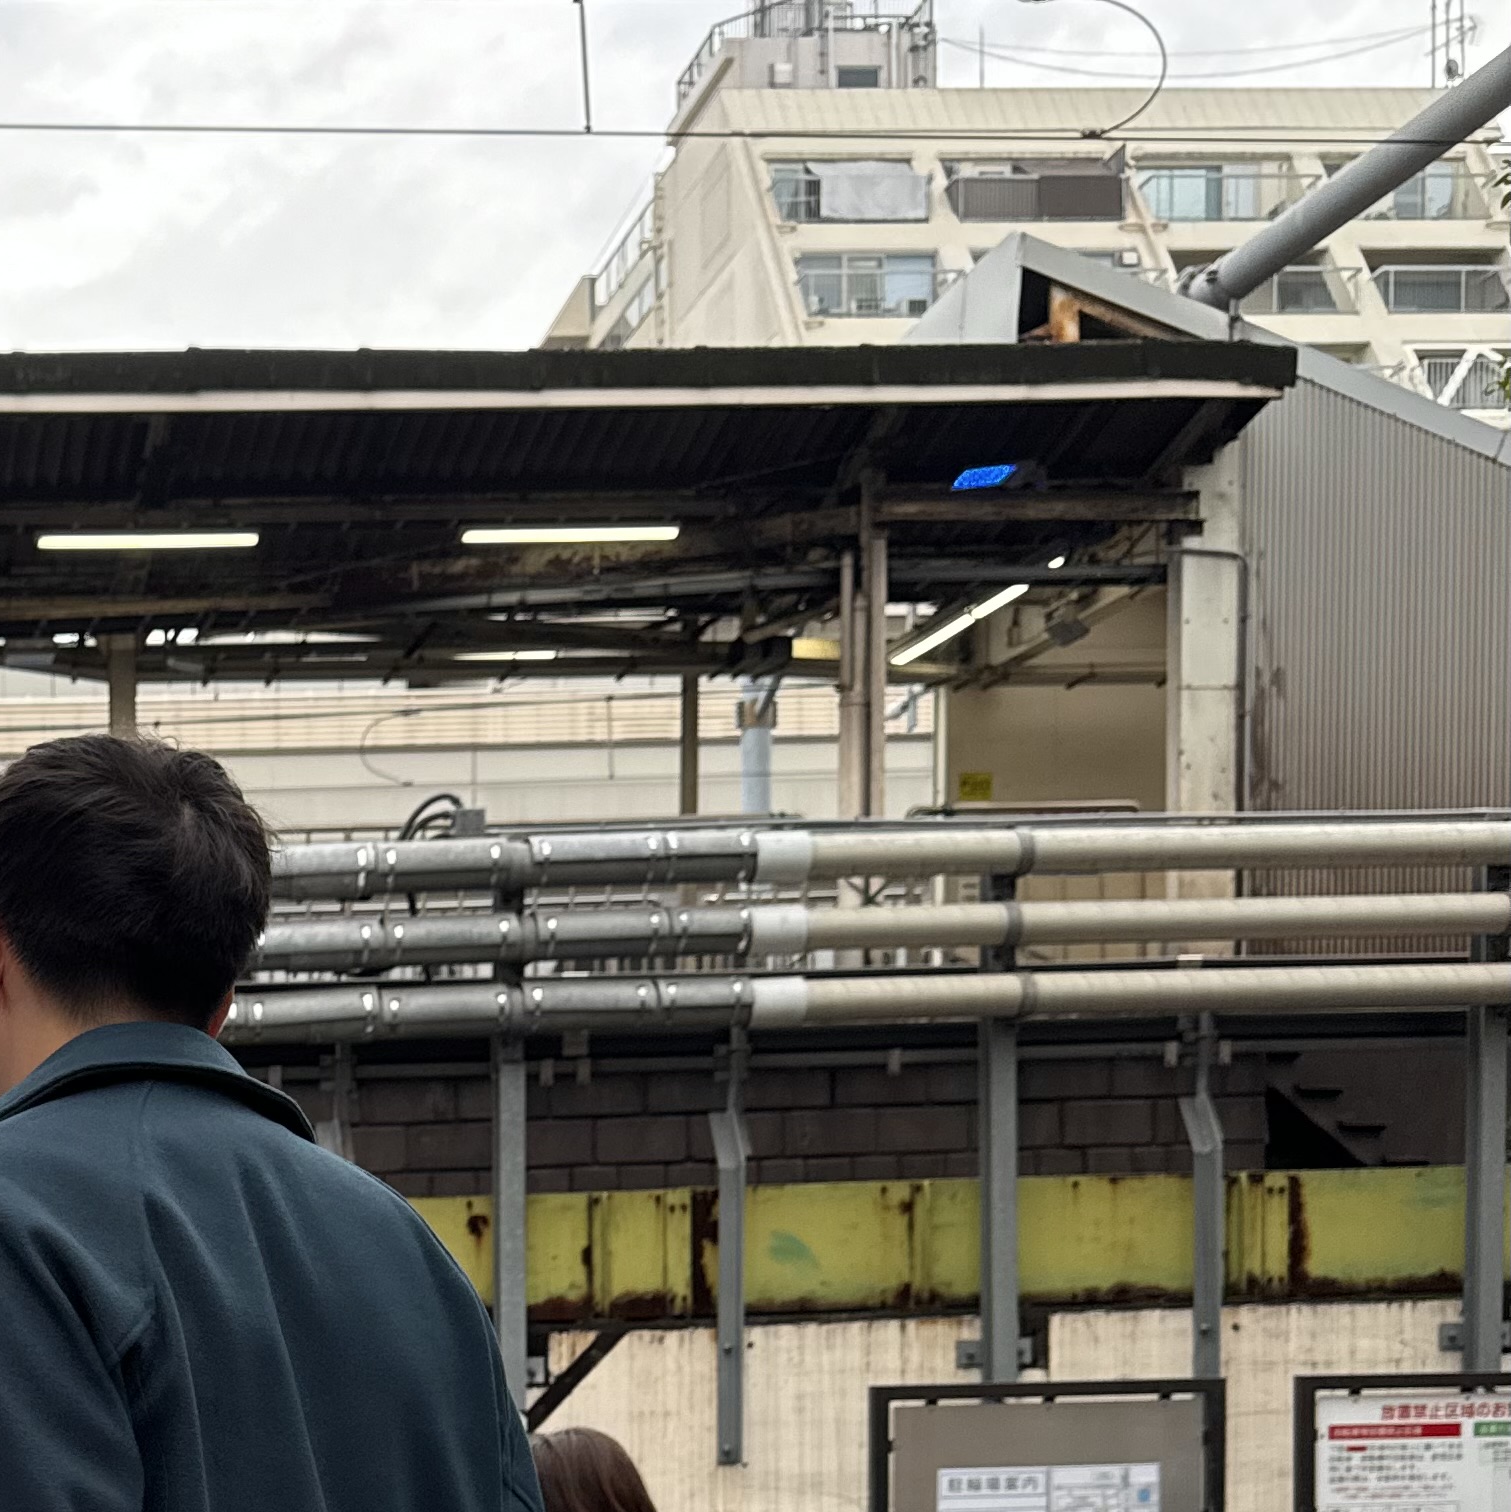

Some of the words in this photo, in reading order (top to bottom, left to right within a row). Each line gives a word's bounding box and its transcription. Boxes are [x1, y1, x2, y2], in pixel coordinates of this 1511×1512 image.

[1381, 1402, 1511, 1420] 放置禁止区域のお
